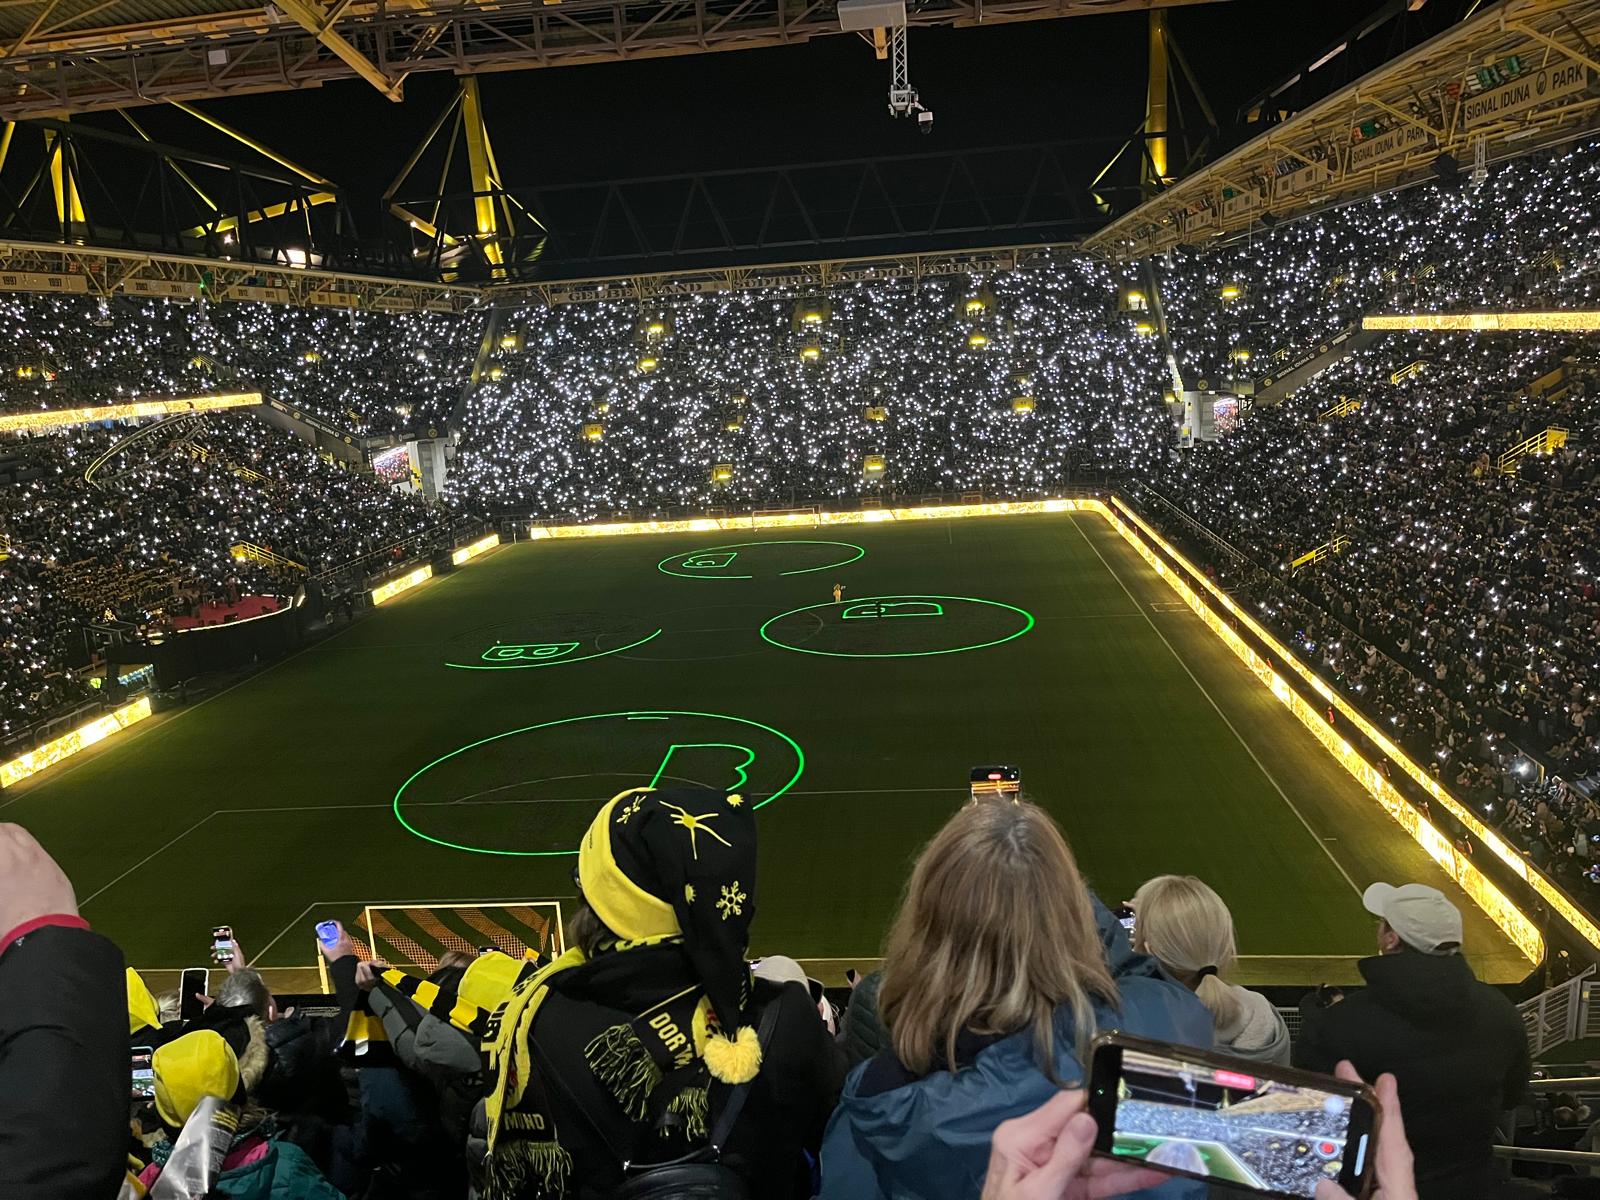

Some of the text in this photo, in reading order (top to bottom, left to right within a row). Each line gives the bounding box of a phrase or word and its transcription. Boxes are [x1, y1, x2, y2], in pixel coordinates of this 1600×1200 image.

[1466, 63, 1584, 120] SIGNAL IDUNA PARK
[1375, 136, 1394, 156] IDUNA
[1406, 126, 1425, 143] PARK
[568, 290, 633, 302] GELBE
[645, 283, 703, 295] WAND
